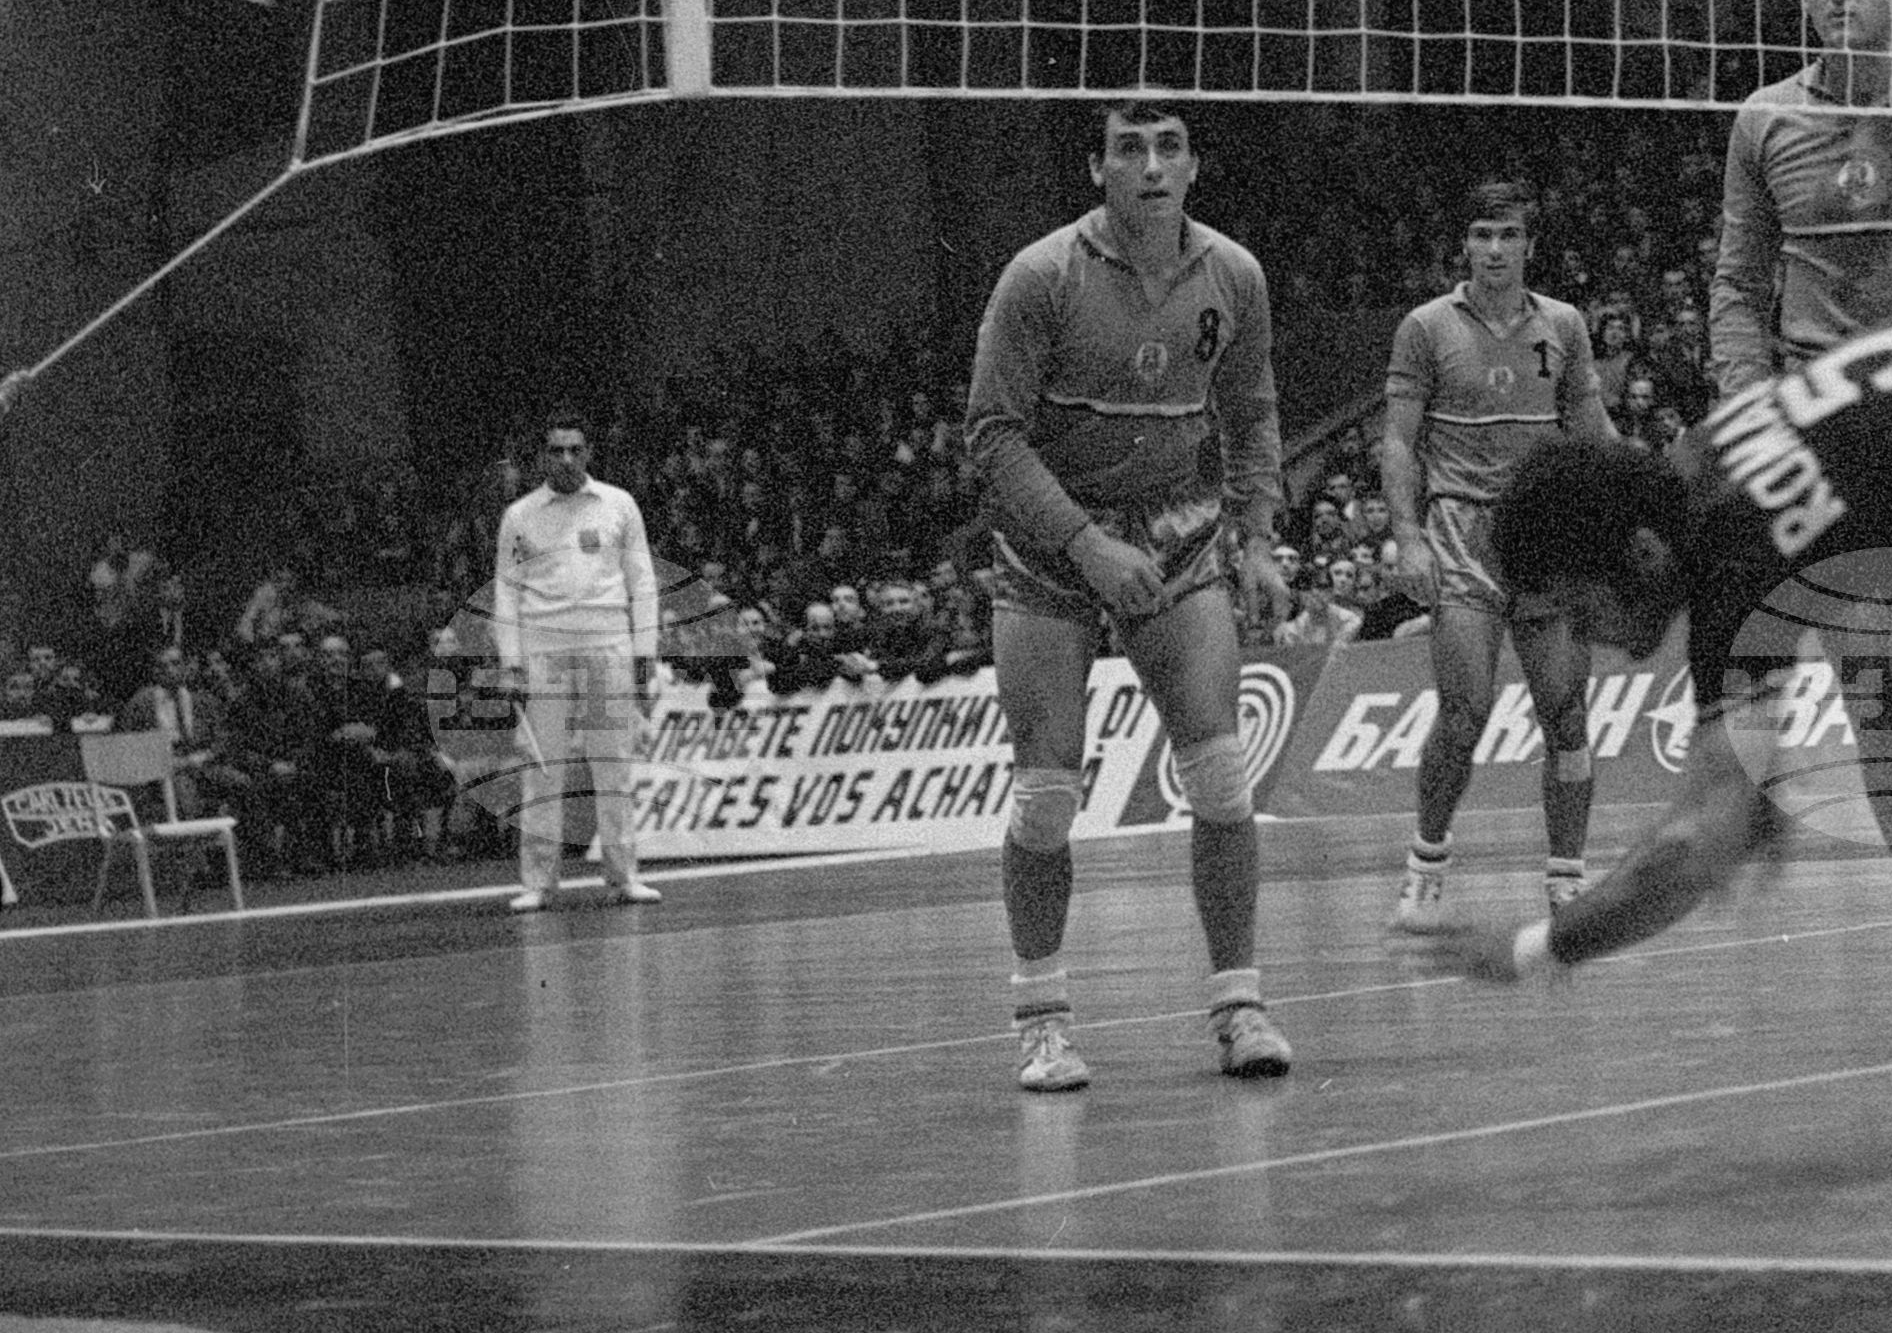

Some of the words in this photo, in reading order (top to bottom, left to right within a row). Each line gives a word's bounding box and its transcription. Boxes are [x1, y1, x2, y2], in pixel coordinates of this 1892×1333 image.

[1194, 307, 1220, 363] 8
[1533, 339, 1552, 379] 1
[636, 706, 811, 763] ПРАВЕТЕ
[781, 770, 876, 829] VOS
